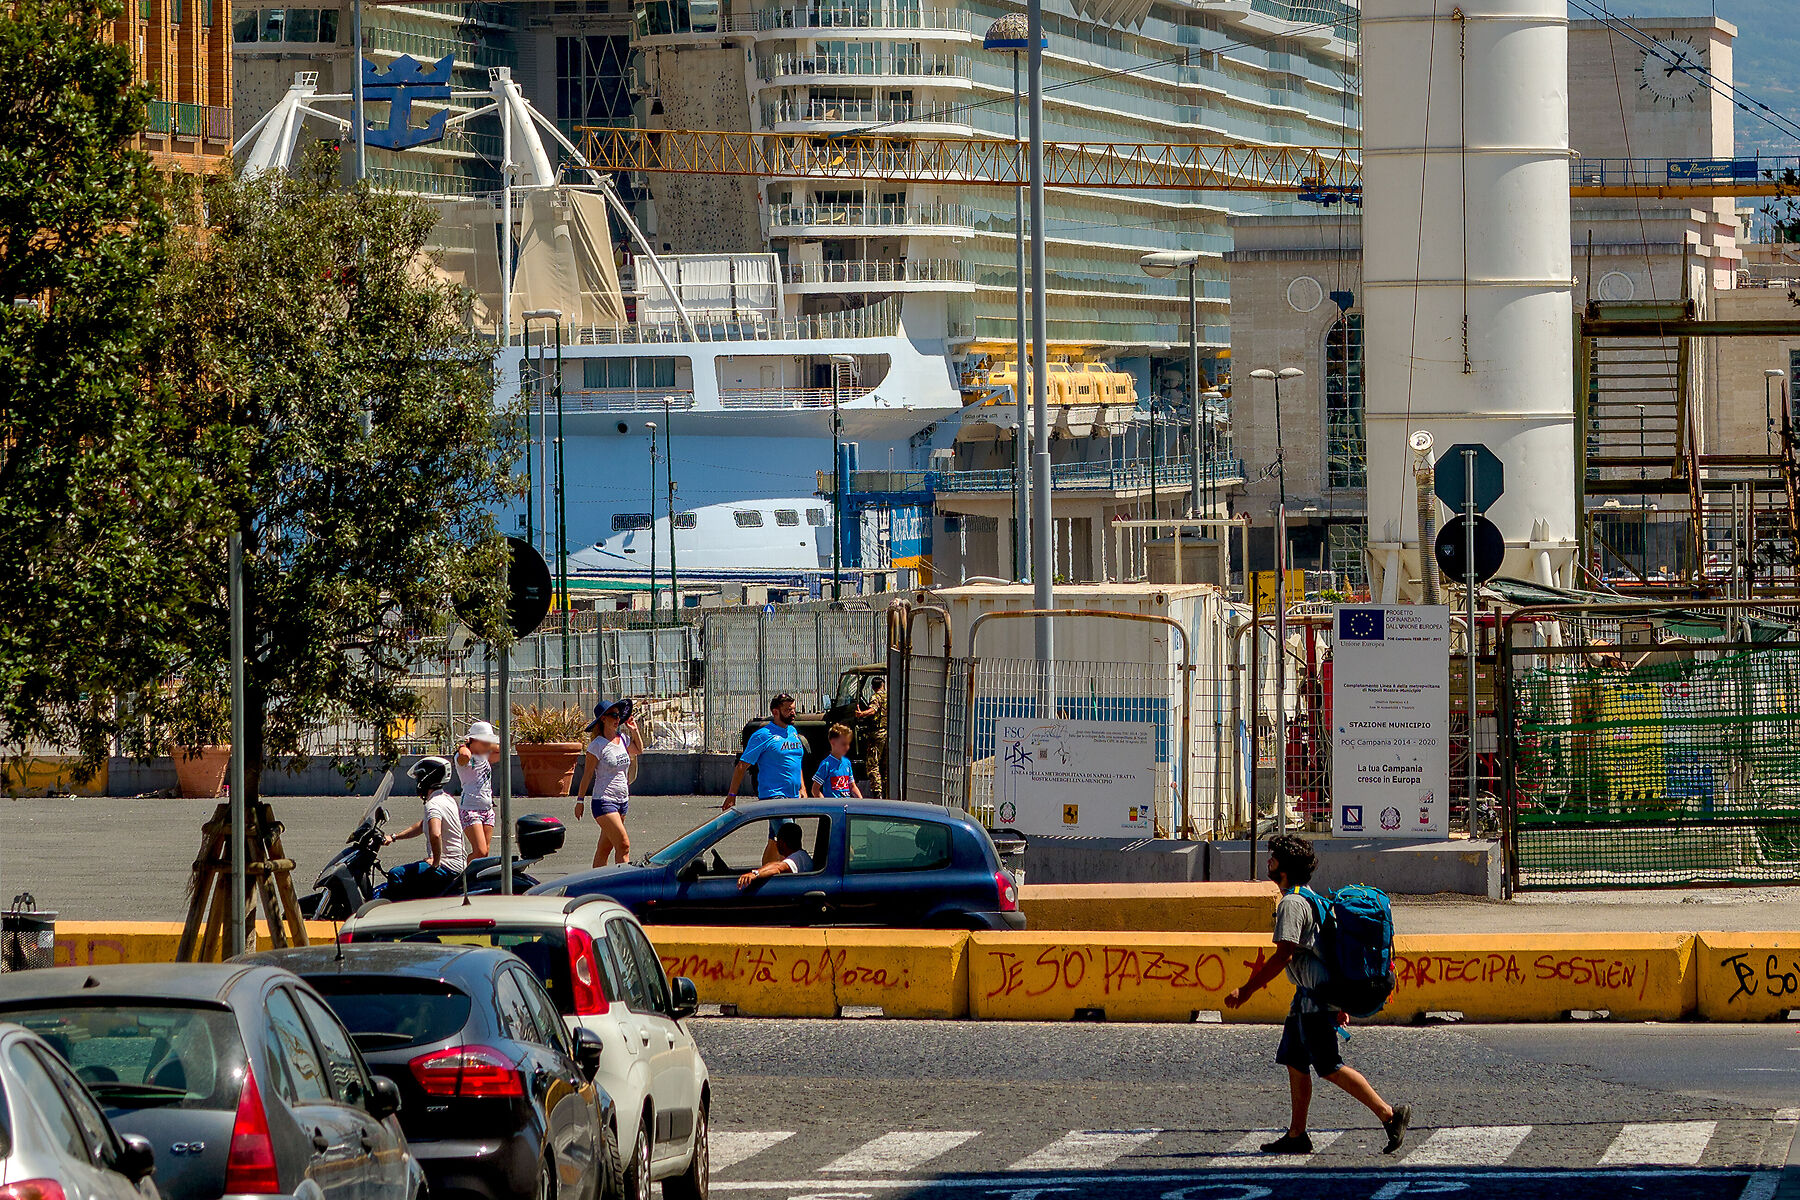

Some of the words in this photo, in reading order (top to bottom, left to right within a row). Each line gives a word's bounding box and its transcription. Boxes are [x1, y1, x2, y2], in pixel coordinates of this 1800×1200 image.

[1004, 727, 1025, 738] FSC
[1357, 764, 1366, 772] La
[1368, 764, 1380, 772] tua
[1382, 764, 1423, 773] Campania
[1392, 776, 1421, 785] Europa
[1103, 946, 1226, 995] PAZZO
